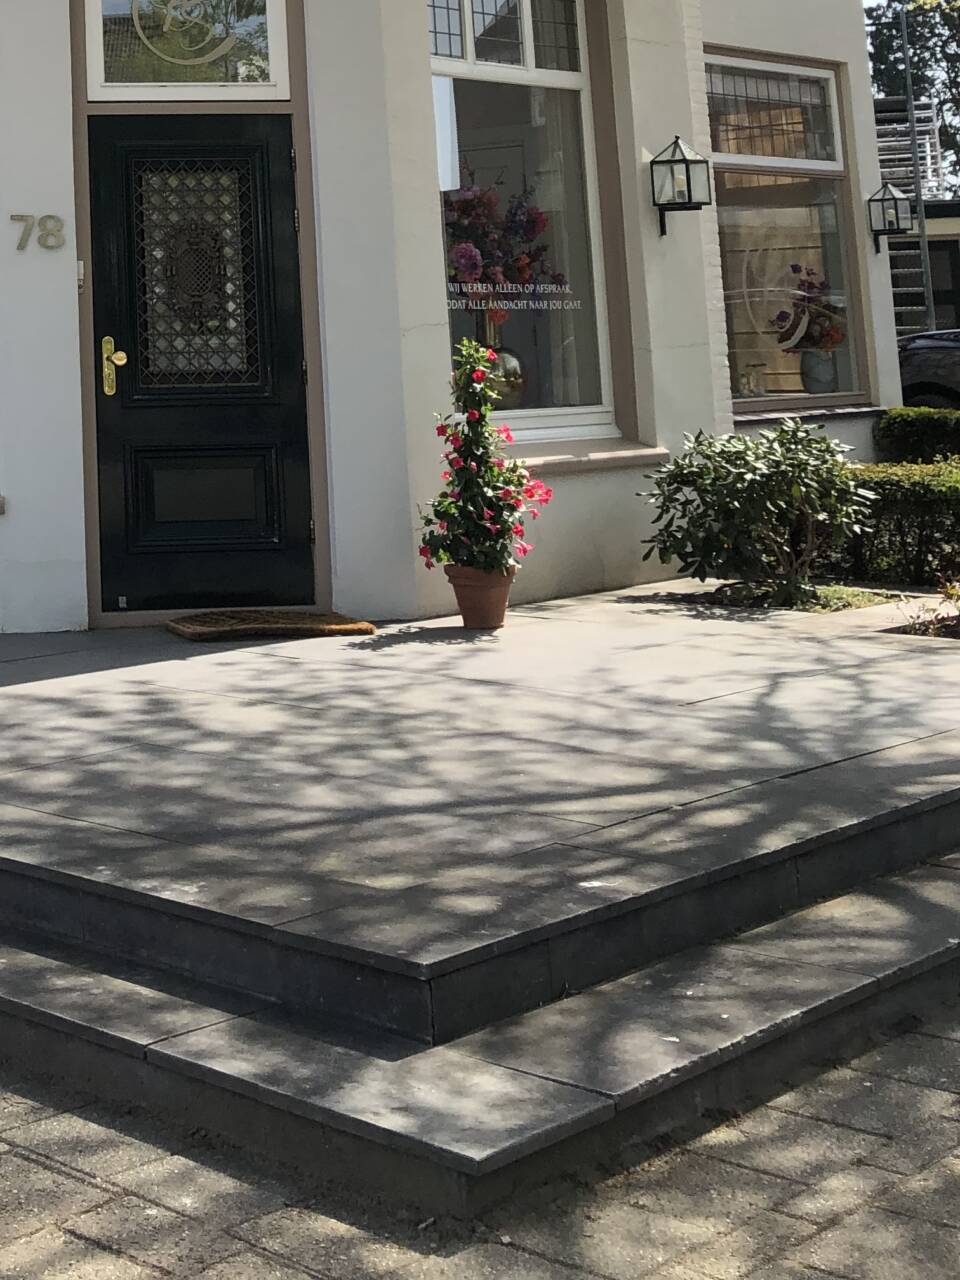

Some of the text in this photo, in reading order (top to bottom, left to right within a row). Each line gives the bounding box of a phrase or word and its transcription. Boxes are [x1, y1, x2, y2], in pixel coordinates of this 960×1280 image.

[10, 214, 66, 251] 78
[448, 283, 459, 293] WIJ
[461, 283, 493, 293] WERKEN
[495, 284, 522, 293] ALLEEN
[524, 284, 535, 293] OP
[447, 300, 467, 309] ODAT
[468, 300, 486, 309] ALLE
[488, 300, 527, 310] AANDACHT
[529, 300, 548, 310] NAAR
[549, 300, 562, 310] JOU
